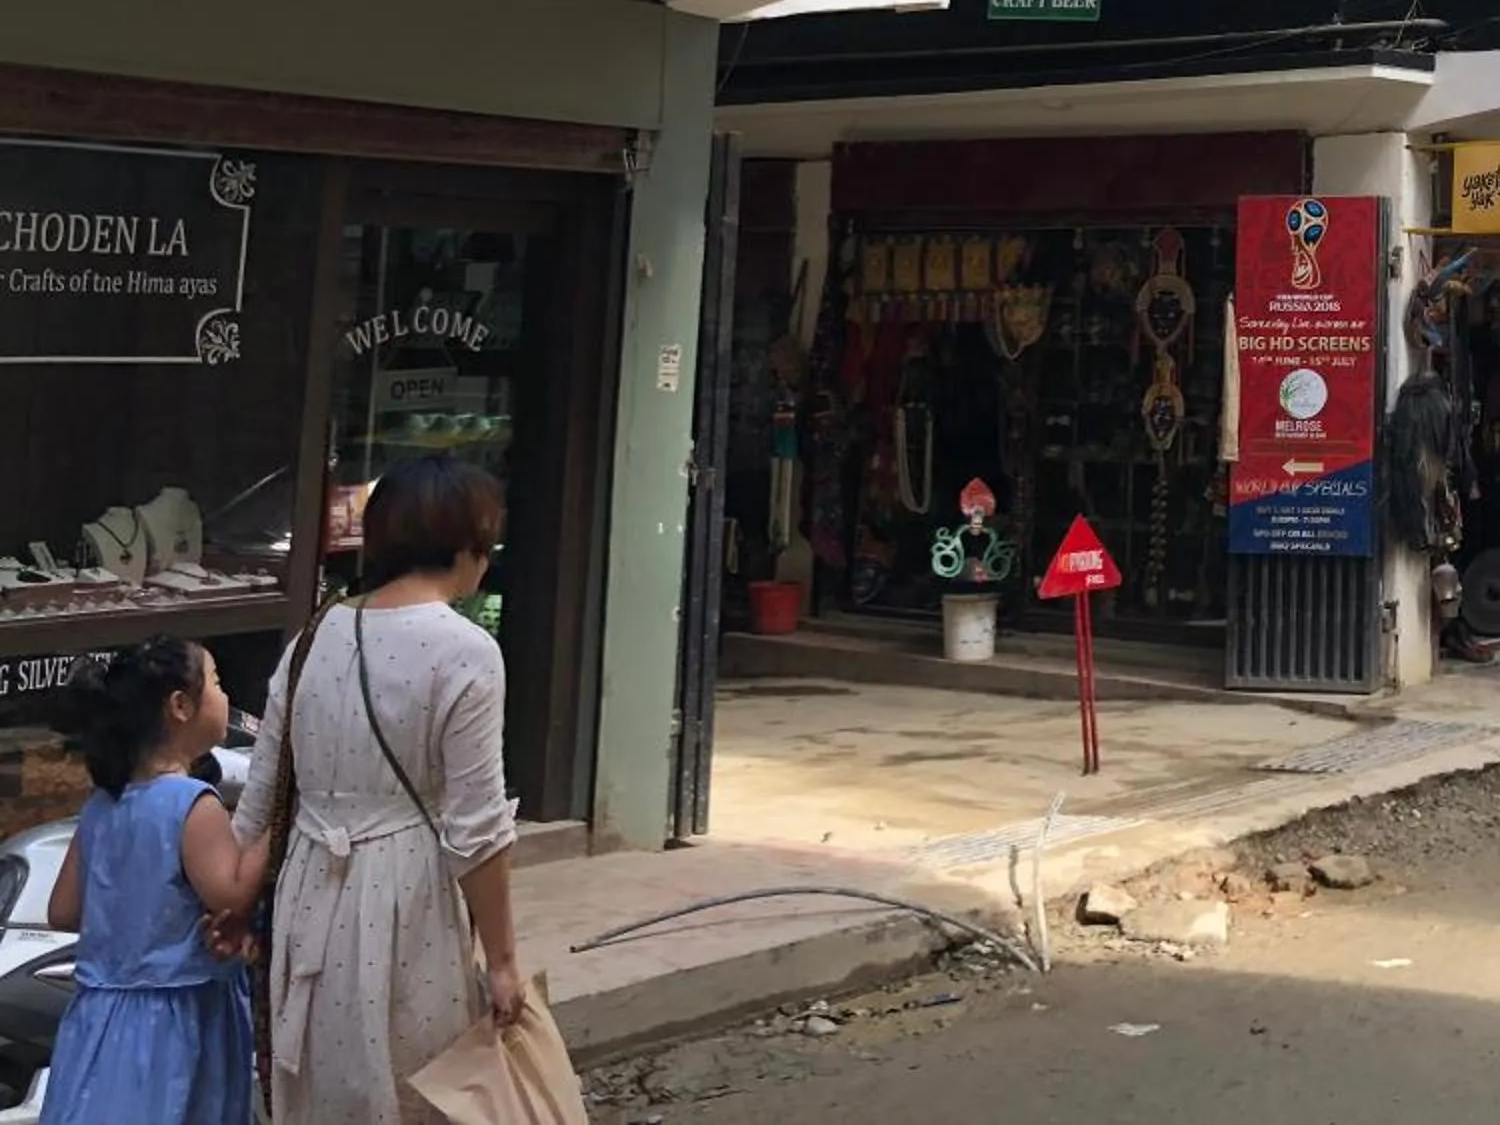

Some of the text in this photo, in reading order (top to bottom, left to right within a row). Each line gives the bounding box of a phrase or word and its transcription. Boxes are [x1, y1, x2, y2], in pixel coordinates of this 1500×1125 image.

[148, 218, 189, 256] LA
[9, 268, 65, 292] Crafts
[69, 268, 92, 292] of
[127, 270, 217, 299] Himaayas
[1269, 300, 1341, 312] RUSSIA 2018
[345, 305, 489, 355] WELCOME
[1239, 336, 1371, 352] BIG HD SCREENS
[390, 378, 445, 400] OPEN
[1275, 420, 1323, 432] MELROSE
[1303, 480, 1368, 496] SPECIALS
[18, 656, 76, 691] SILVE
